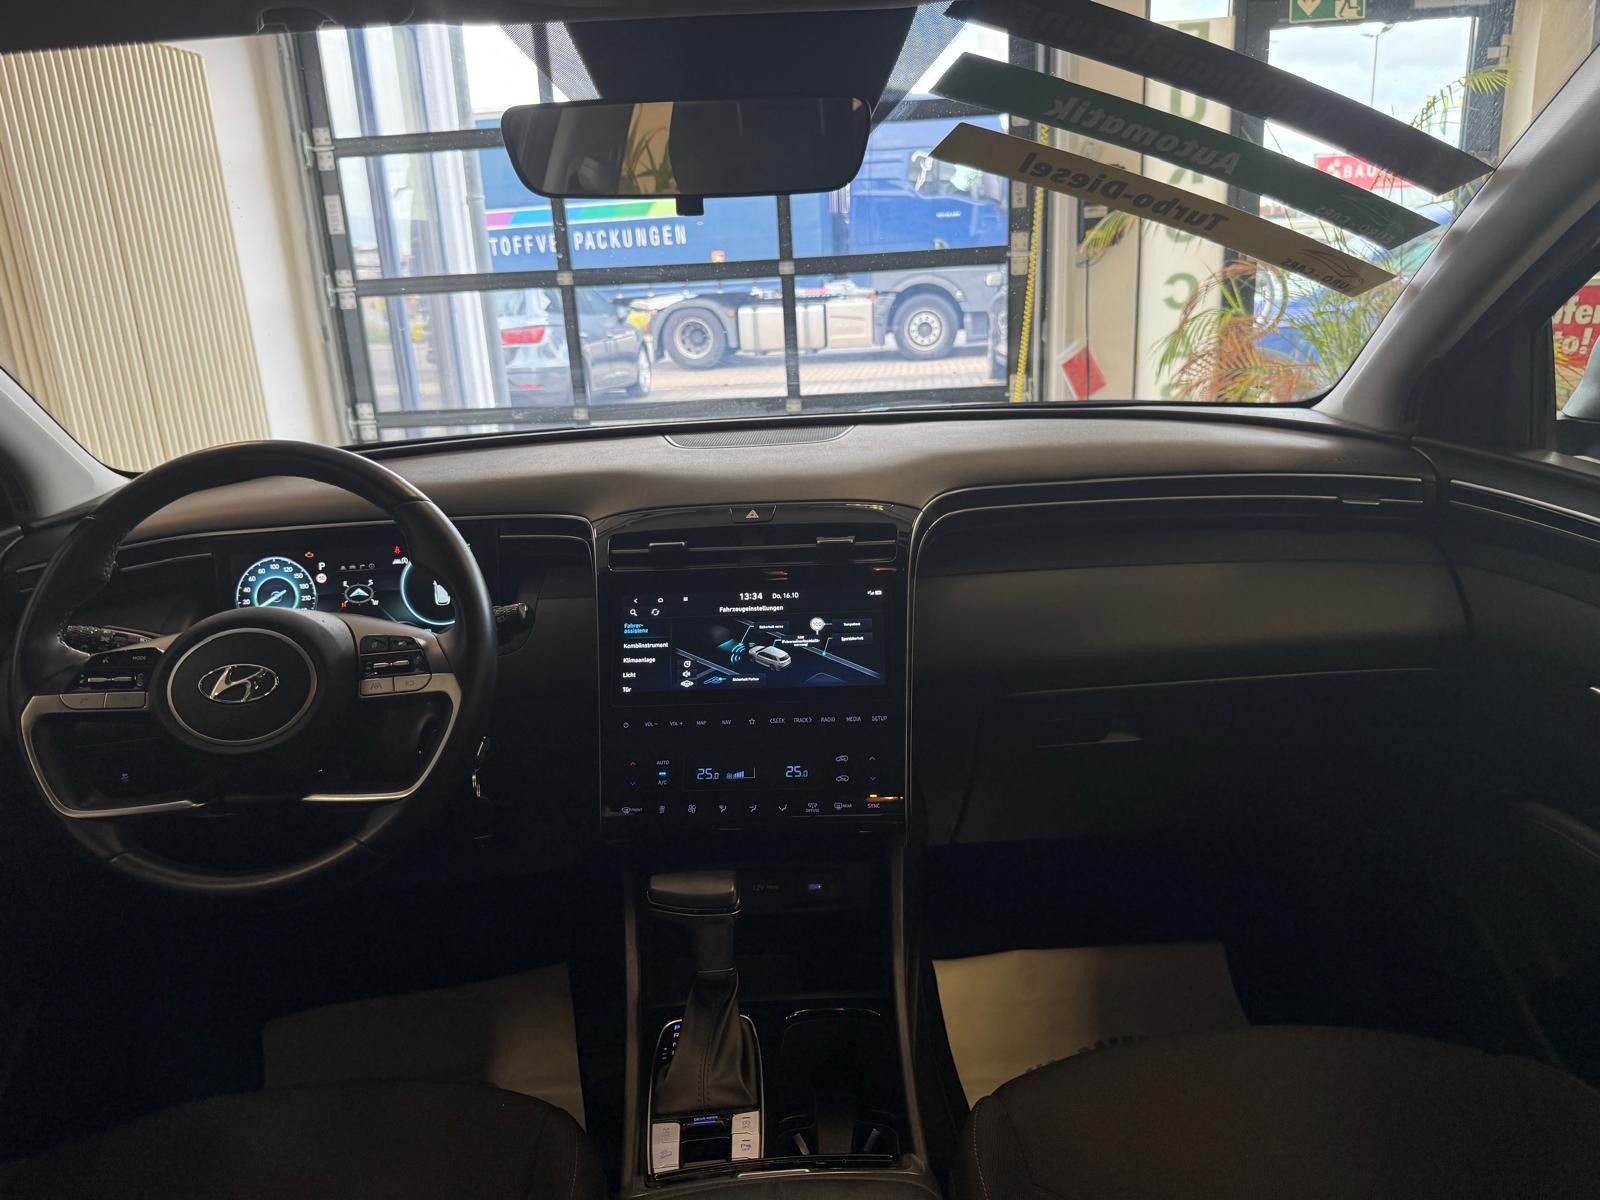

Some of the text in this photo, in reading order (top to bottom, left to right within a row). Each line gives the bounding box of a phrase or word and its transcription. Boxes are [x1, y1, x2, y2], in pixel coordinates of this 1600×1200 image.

[318, 562, 326, 571] P
[739, 592, 763, 601] 13:34
[719, 605, 784, 613] Fahrzeugeinstellungen
